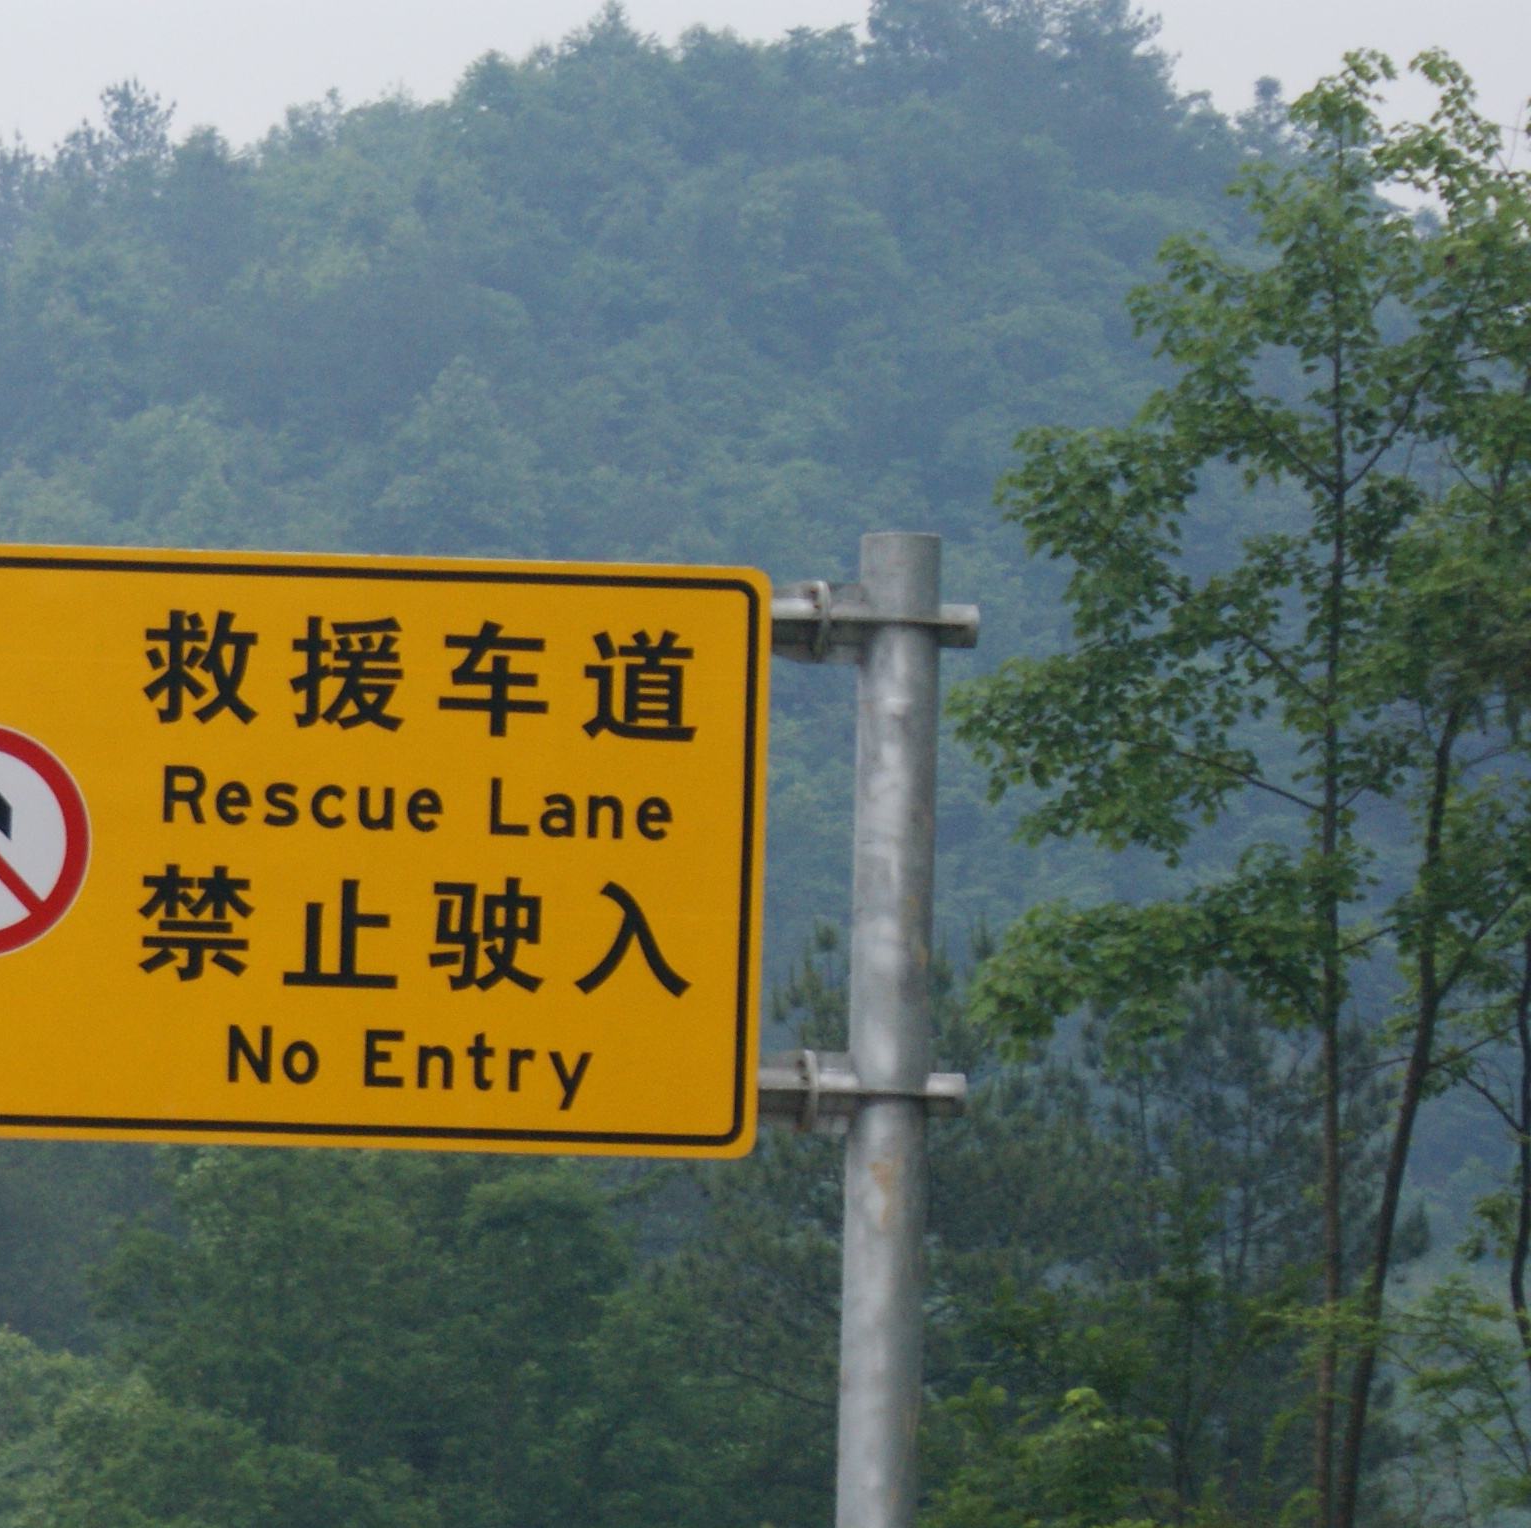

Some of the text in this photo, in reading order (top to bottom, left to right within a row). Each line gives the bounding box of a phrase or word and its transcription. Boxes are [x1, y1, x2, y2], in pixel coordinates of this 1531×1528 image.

[142, 609, 697, 743] 救援车道
[162, 765, 674, 841] Rescue Lane
[138, 862, 691, 999] 禁止驶入
[227, 1024, 592, 1111] No Entry
